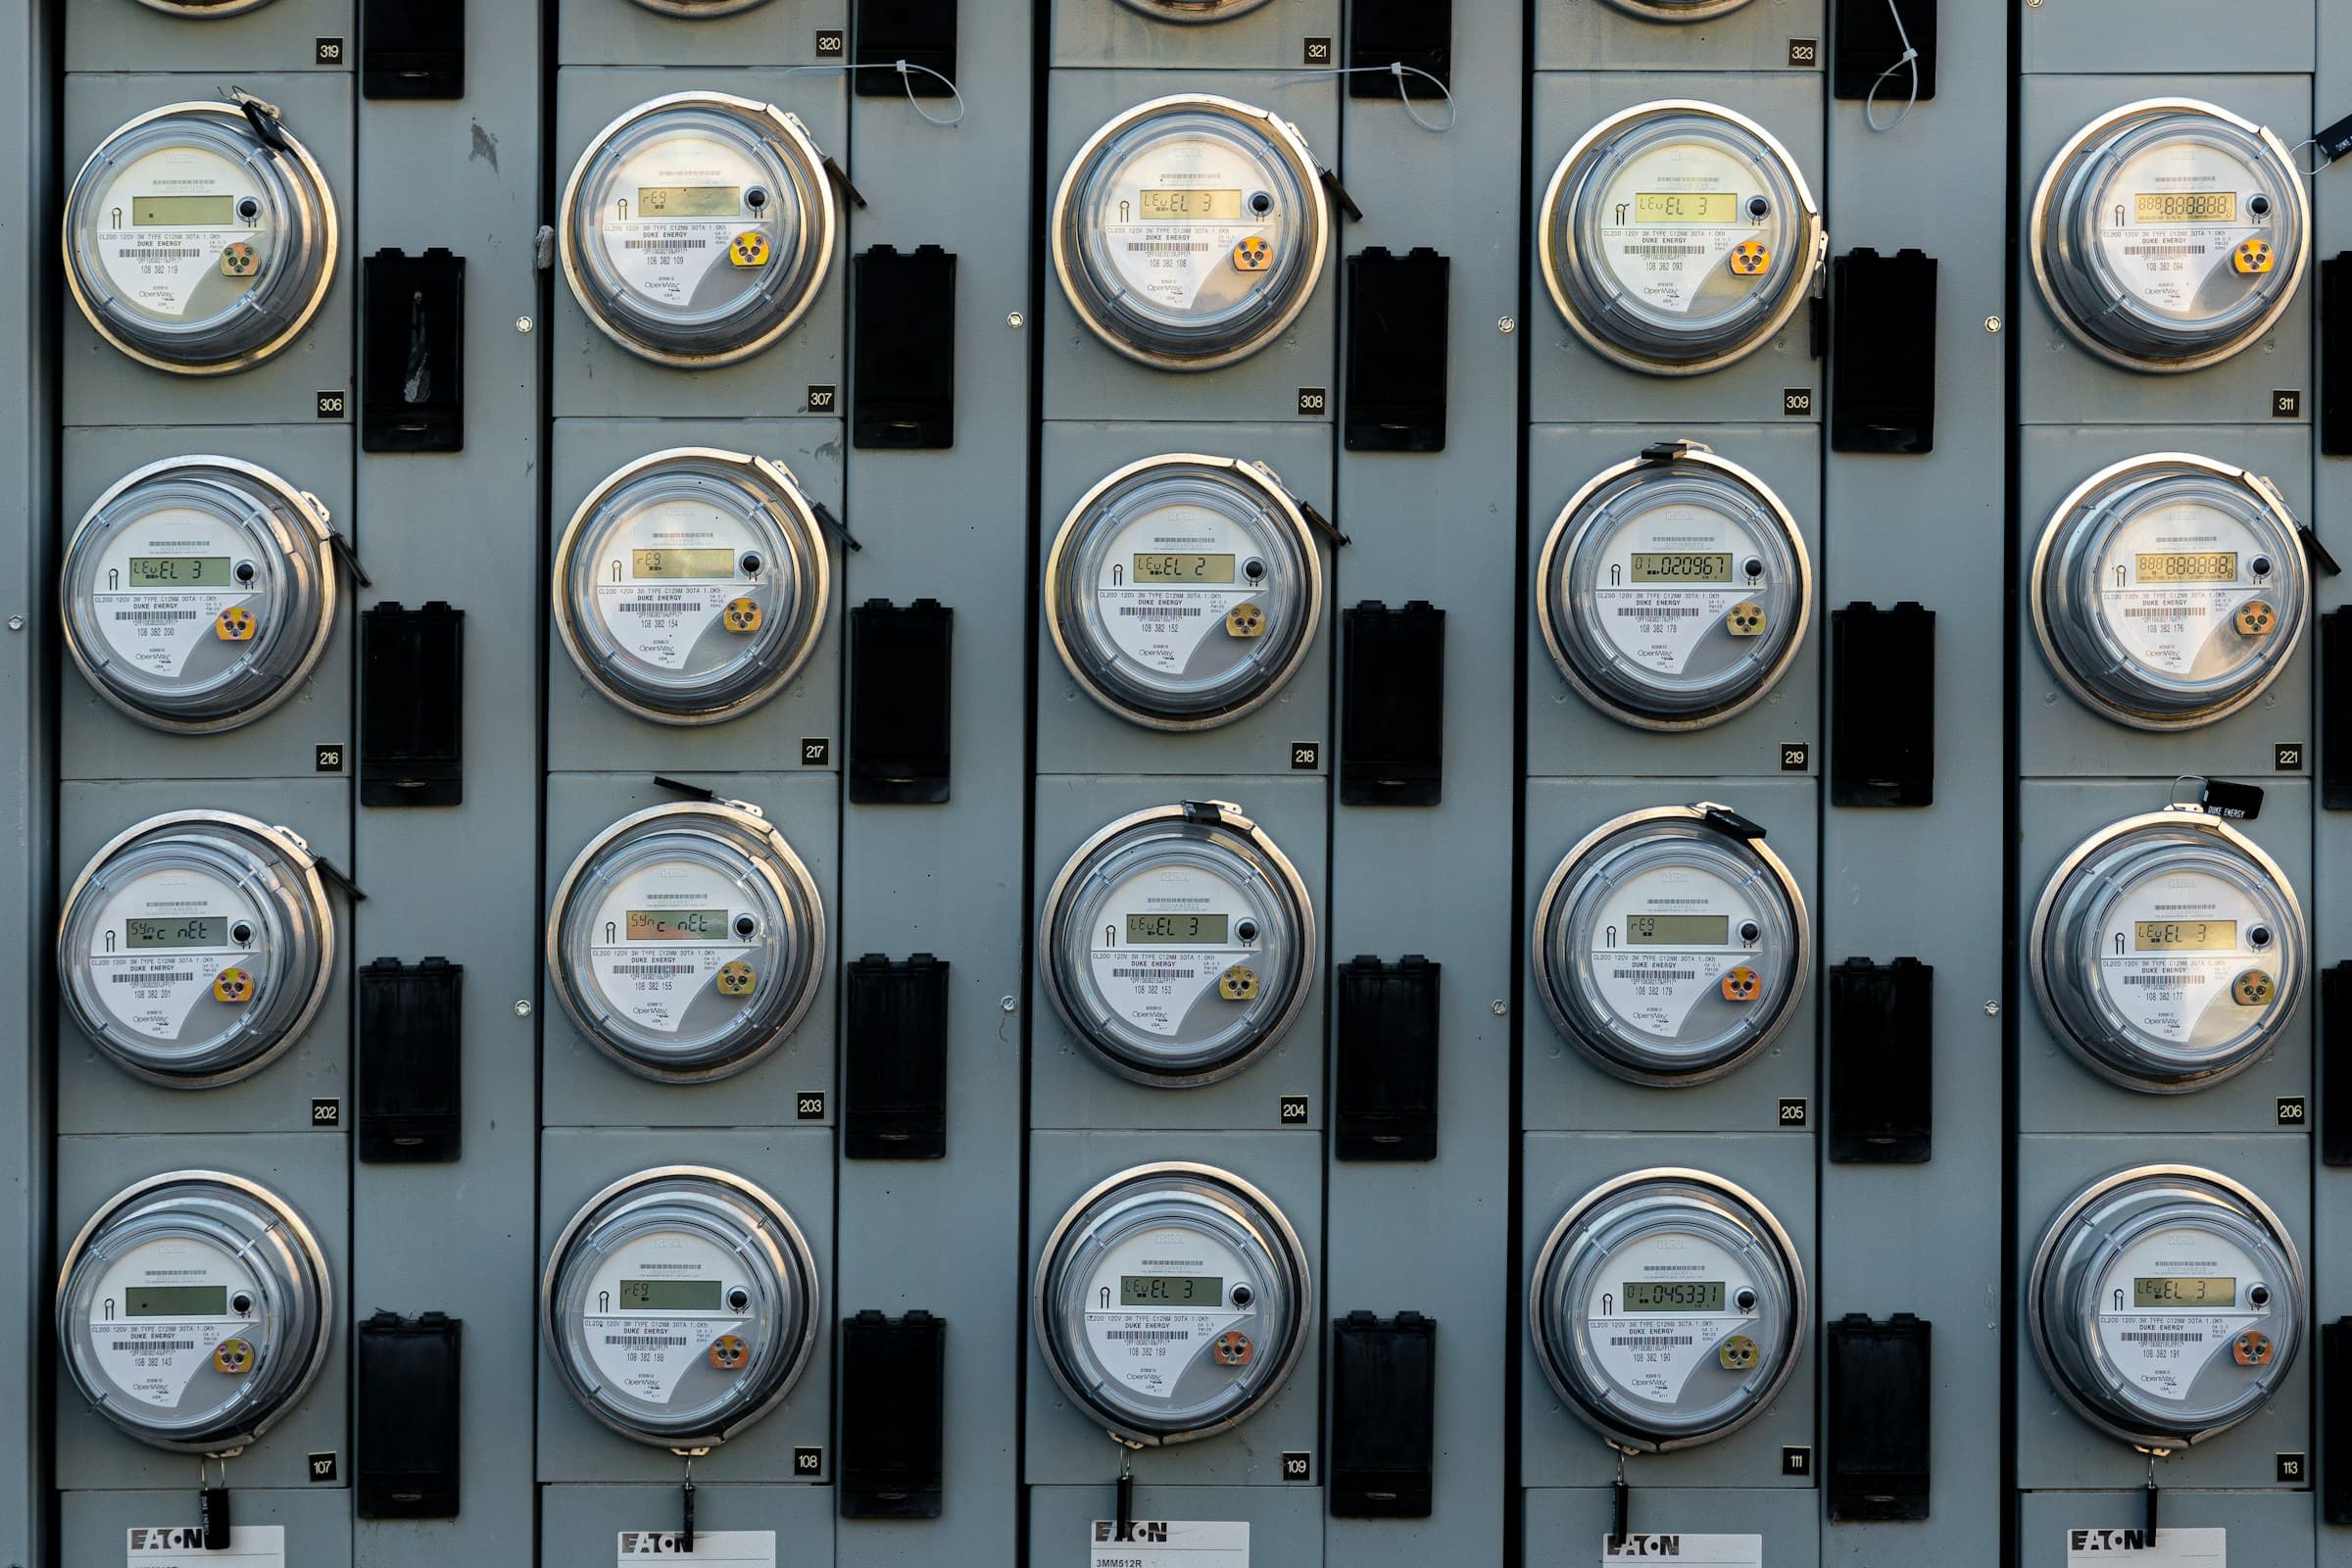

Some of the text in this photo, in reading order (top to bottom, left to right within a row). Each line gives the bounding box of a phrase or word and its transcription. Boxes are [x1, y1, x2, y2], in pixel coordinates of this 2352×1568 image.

[819, 37, 840, 50] 320
[320, 44, 338, 58] 319
[1308, 45, 1326, 58] 321
[1792, 47, 1813, 60] 323
[1202, 194, 1212, 212] 3
[1699, 197, 1707, 215] 3
[674, 256, 683, 265] 109
[1151, 259, 1159, 268] 108
[1162, 259, 1173, 268] 382
[1646, 262, 1683, 270] 108 382 093
[2147, 263, 2156, 271] 108
[2160, 262, 2170, 270] 382
[319, 399, 342, 411] 306
[810, 393, 832, 405] 307
[1300, 395, 1323, 408] 308
[1787, 396, 1809, 408] 309
[2278, 398, 2293, 411] 311
[192, 561, 202, 579] 3
[1196, 558, 1205, 575] 2
[1661, 557, 1724, 575] 020967
[642, 619, 651, 628] 108
[655, 619, 664, 628] 382
[1142, 623, 1178, 632] 108 382 152
[1640, 624, 1677, 633] 108 382 178
[2147, 624, 2157, 633] 108
[2161, 624, 2170, 633] 382
[138, 627, 173, 637] 108 382 200
[806, 746, 823, 758] 217
[1296, 750, 1314, 762] 218
[1786, 752, 1803, 763] 219
[2279, 751, 2298, 763] 221
[319, 753, 338, 764] 216
[2208, 805, 2245, 818] DUKE ENERGY
[1190, 917, 1199, 936] 3
[2198, 924, 2206, 942] 3
[635, 982, 645, 991] 108
[649, 982, 659, 991] 382
[1135, 985, 1171, 995] 108 382 153
[1636, 986, 1672, 996] 108 382 179
[134, 990, 171, 999] 108 382 201
[2146, 992, 2182, 1002] 108 382 177
[800, 1100, 821, 1112] 203
[1284, 1104, 1305, 1116] 204
[2279, 1104, 2302, 1117] 206
[315, 1106, 336, 1119] 202
[1782, 1106, 1803, 1119] 205
[1184, 1280, 1193, 1298] 3
[1653, 1286, 1716, 1303] 045331
[2197, 1281, 2205, 1298] 3
[627, 1352, 637, 1361] 108
[641, 1352, 650, 1361] 382
[1129, 1348, 1139, 1356] 108
[1143, 1348, 1152, 1356] 382
[1634, 1352, 1670, 1362] 108 382 190
[2143, 1349, 2153, 1358] 108
[2156, 1349, 2167, 1358] 382
[135, 1357, 144, 1366] 108
[148, 1357, 158, 1366] 382
[799, 1455, 817, 1468] 108
[1287, 1460, 1306, 1473] 109
[1790, 1455, 1802, 1467] 111
[314, 1461, 332, 1474] 107
[2283, 1461, 2298, 1474] 113
[131, 1529, 202, 1549] EATON
[2072, 1530, 2143, 1550] EATON
[1096, 1559, 1142, 1568] 3MM512R
